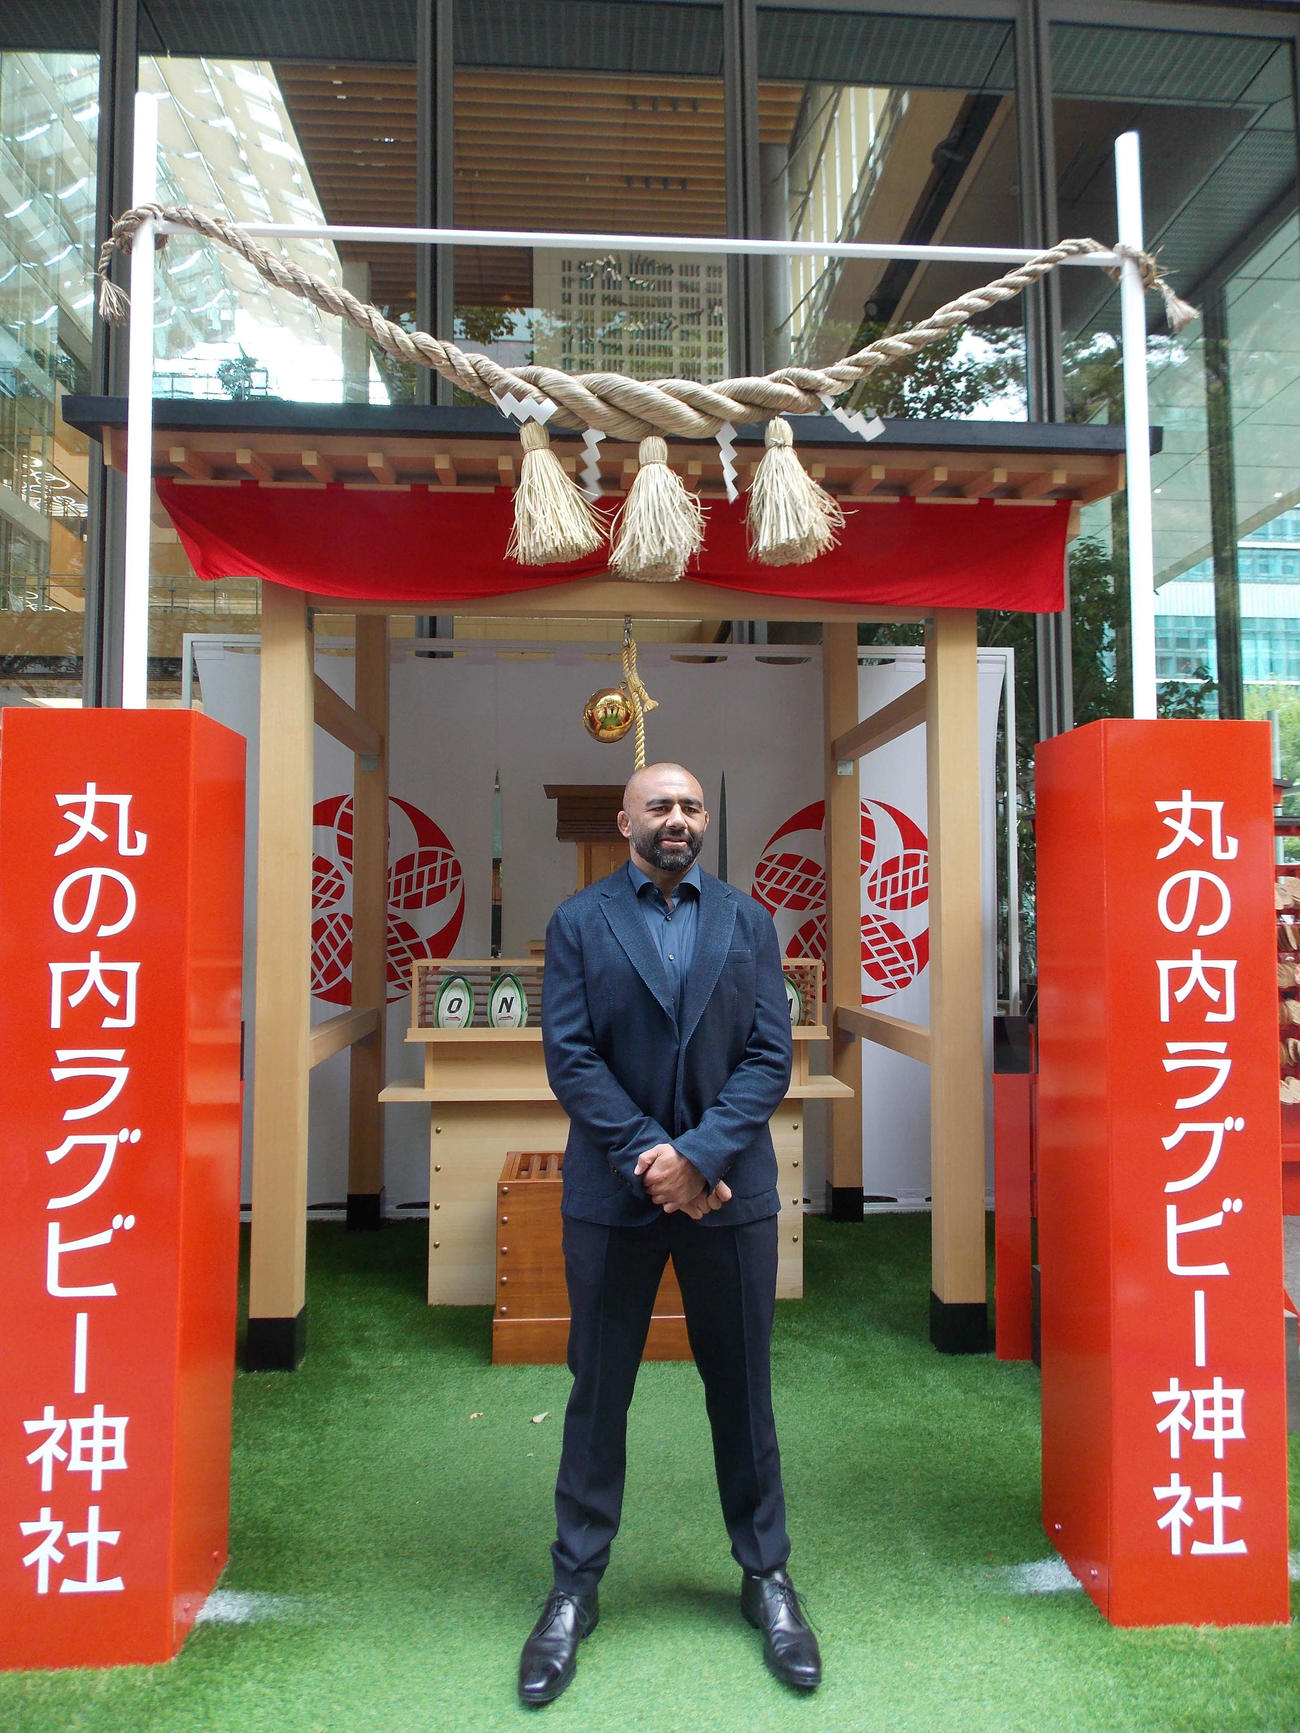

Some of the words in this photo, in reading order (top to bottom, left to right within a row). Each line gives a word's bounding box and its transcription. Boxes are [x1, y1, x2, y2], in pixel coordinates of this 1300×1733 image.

[20, 782, 147, 1594] 丸の内ラグビー神社
[1152, 790, 1247, 1555] 丸の内ラグビー神社
